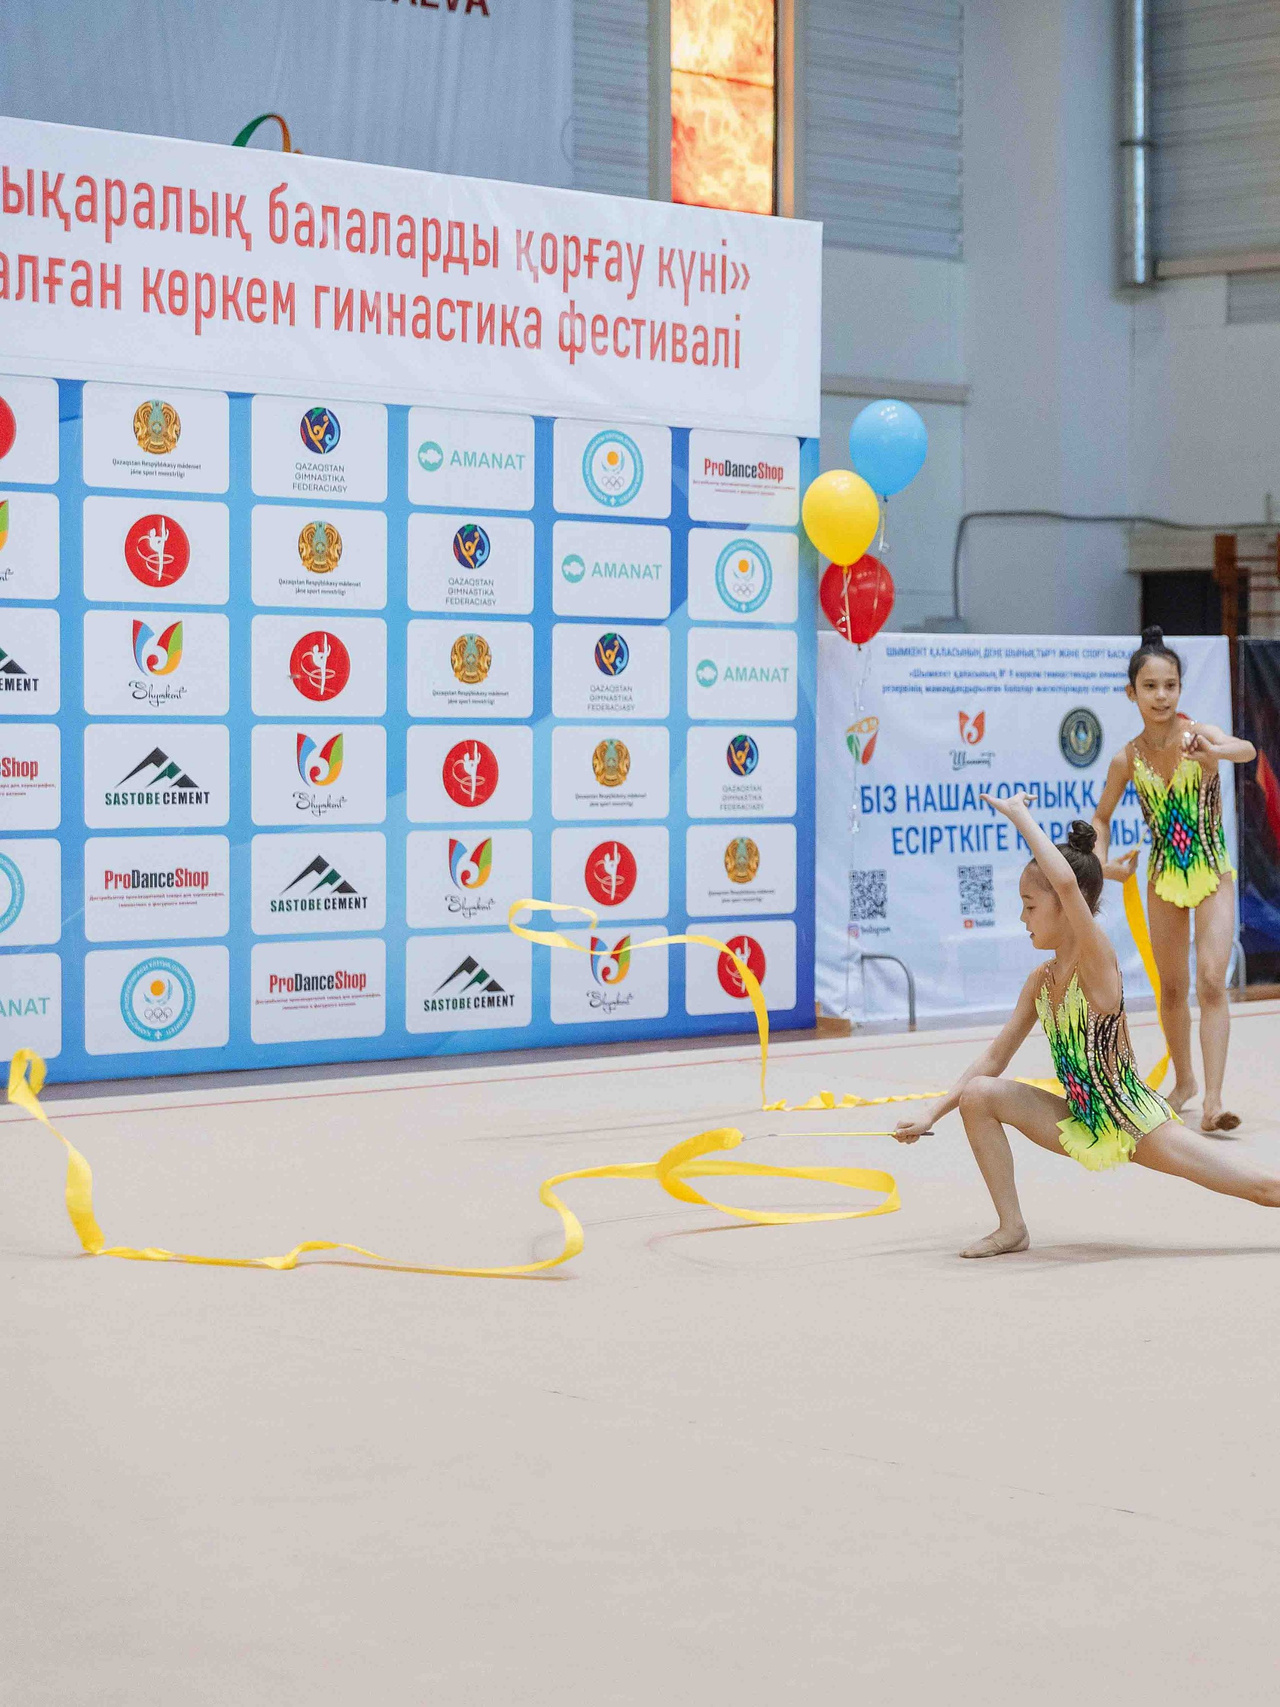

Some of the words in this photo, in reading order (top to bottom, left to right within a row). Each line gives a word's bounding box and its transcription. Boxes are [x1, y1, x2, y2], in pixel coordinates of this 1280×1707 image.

[268, 181, 499, 278] балаларды
[515, 228, 645, 301] қорғау
[658, 238, 751, 306] күні»
[142, 265, 296, 336] көркем
[313, 284, 542, 349] гимнастика
[558, 299, 741, 369] фестивалі
[295, 462, 345, 473] QAZAQSTAN
[450, 449, 526, 471] AMANAT
[704, 458, 784, 484] ProDanceShop
[292, 482, 347, 493] FEDERACIASY
[448, 577, 494, 587] QAZAQSTAN
[591, 561, 662, 581] AMANAT
[723, 666, 789, 683] AMANAT
[0, 756, 39, 781] Shop
[860, 785, 897, 814] БІЗ
[892, 822, 1009, 856] ЕСІРТКІГЕ
[104, 867, 209, 890] ProDanceShop
[269, 970, 367, 994] ProDanceShop
